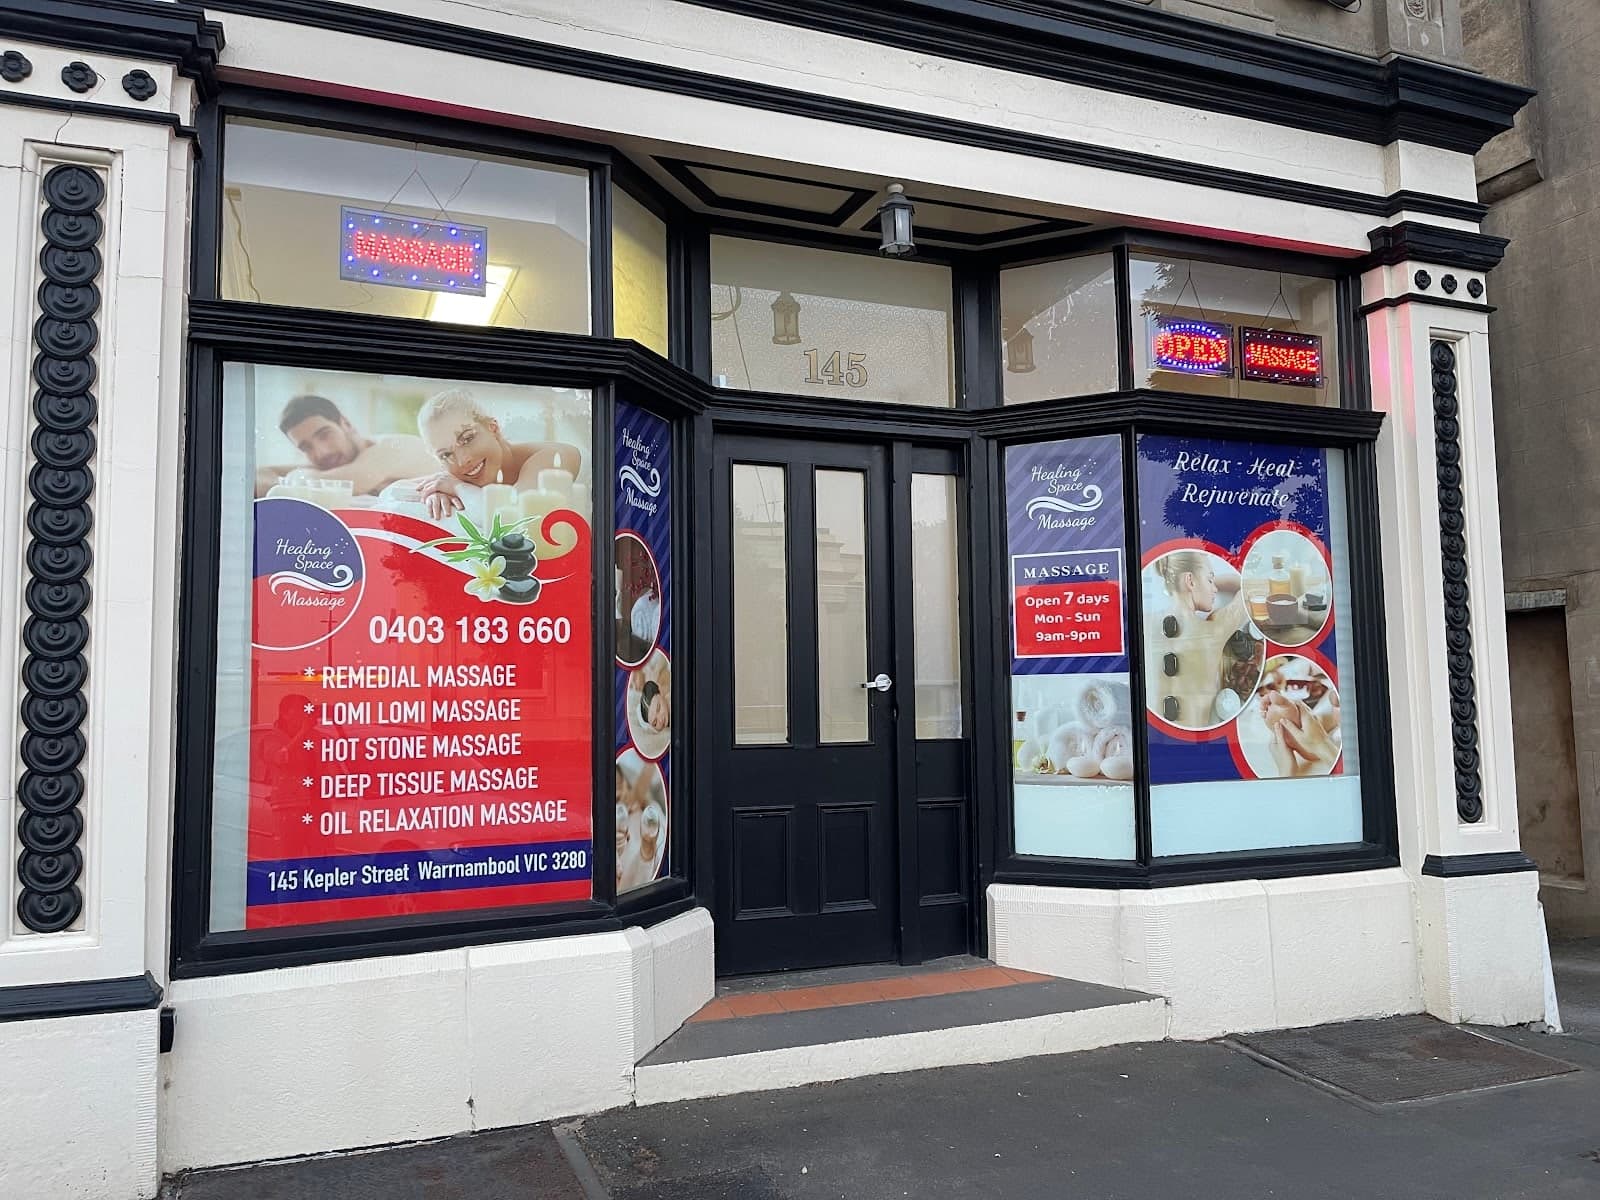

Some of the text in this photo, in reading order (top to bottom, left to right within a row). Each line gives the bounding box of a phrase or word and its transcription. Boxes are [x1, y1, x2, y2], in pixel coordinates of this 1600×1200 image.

[355, 230, 474, 273] MASSAGE
[1156, 333, 1227, 363] OPEN
[1250, 343, 1319, 371] MASSAGE
[804, 348, 868, 388] 145
[622, 428, 650, 459] Healing
[632, 450, 652, 471] Space
[1031, 464, 1081, 482] Healing
[1173, 451, 1231, 474] Relax
[1246, 457, 1295, 478] Heal
[1048, 479, 1083, 496] Space
[1181, 483, 1290, 508] Rejuvenate
[625, 487, 657, 517] Massage
[1037, 514, 1096, 531] Massage
[275, 538, 332, 559] Healing
[294, 555, 334, 573] Space
[1024, 563, 1110, 579] MASSAGE
[280, 589, 345, 608] Massage
[1025, 591, 1110, 608] Open 7 days
[369, 616, 571, 644] 0403 183 660
[1034, 614, 1063, 624] Mon
[1075, 612, 1100, 622] Sun
[1035, 630, 1100, 643] 9am-9pm
[321, 664, 516, 689] REMEDIAL MASSAGE
[321, 699, 521, 726] LOMI LOMI MASSAGE
[321, 733, 522, 762] HOT STONE MASSAGE
[320, 767, 539, 799] DEEP TISSUE MASSAGE
[320, 800, 567, 836] OIL RELAXATION MASSAGE
[268, 850, 586, 893] 145 Kepler Street Warrnambool VIC 3280
